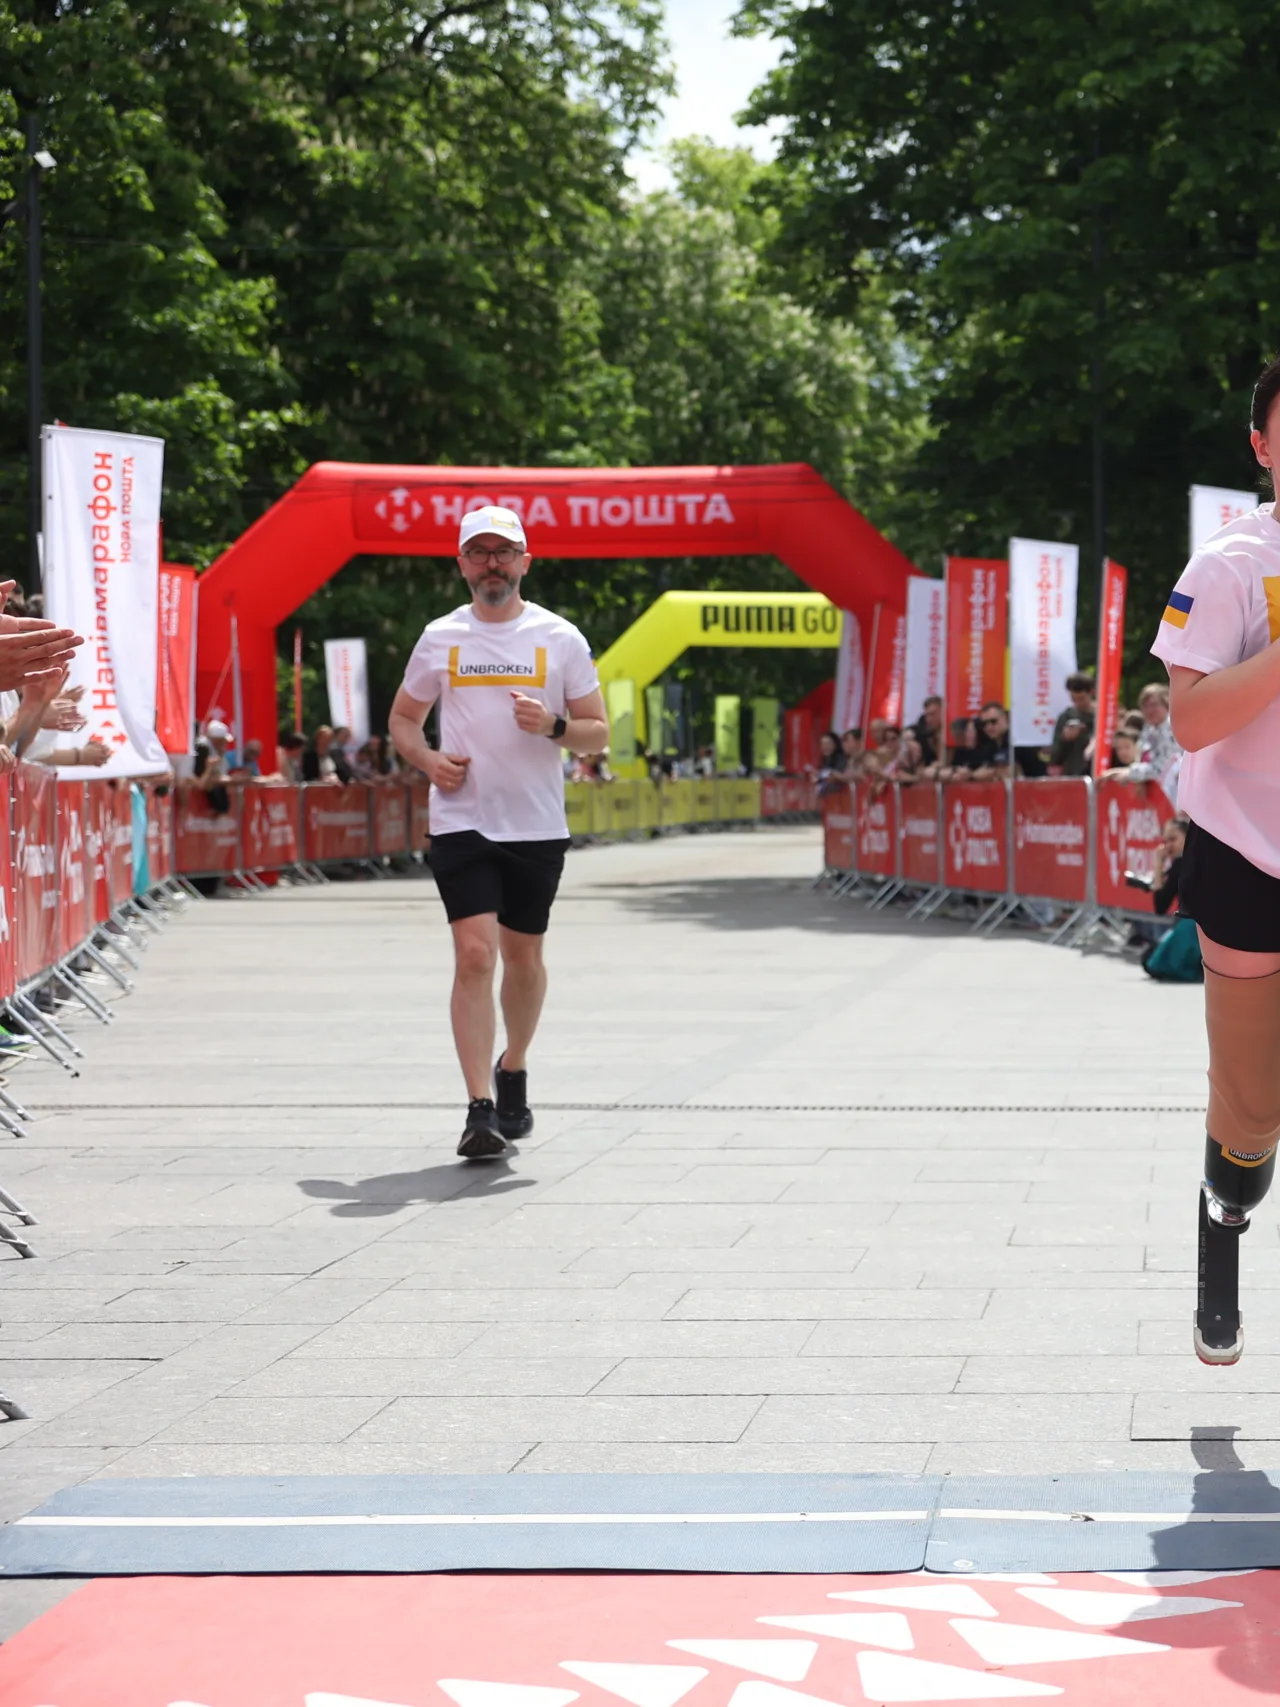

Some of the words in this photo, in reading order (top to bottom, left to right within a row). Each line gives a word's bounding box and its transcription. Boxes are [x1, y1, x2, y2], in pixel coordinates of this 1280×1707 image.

[121, 456, 134, 515] ПОШТА
[567, 493, 735, 527] ПОШТА
[120, 519, 132, 563] НОВА
[88, 451, 117, 710] Напівмарафон
[701, 604, 796, 633] PUMA
[803, 605, 838, 634] GO
[460, 664, 533, 675] UNBROKEN
